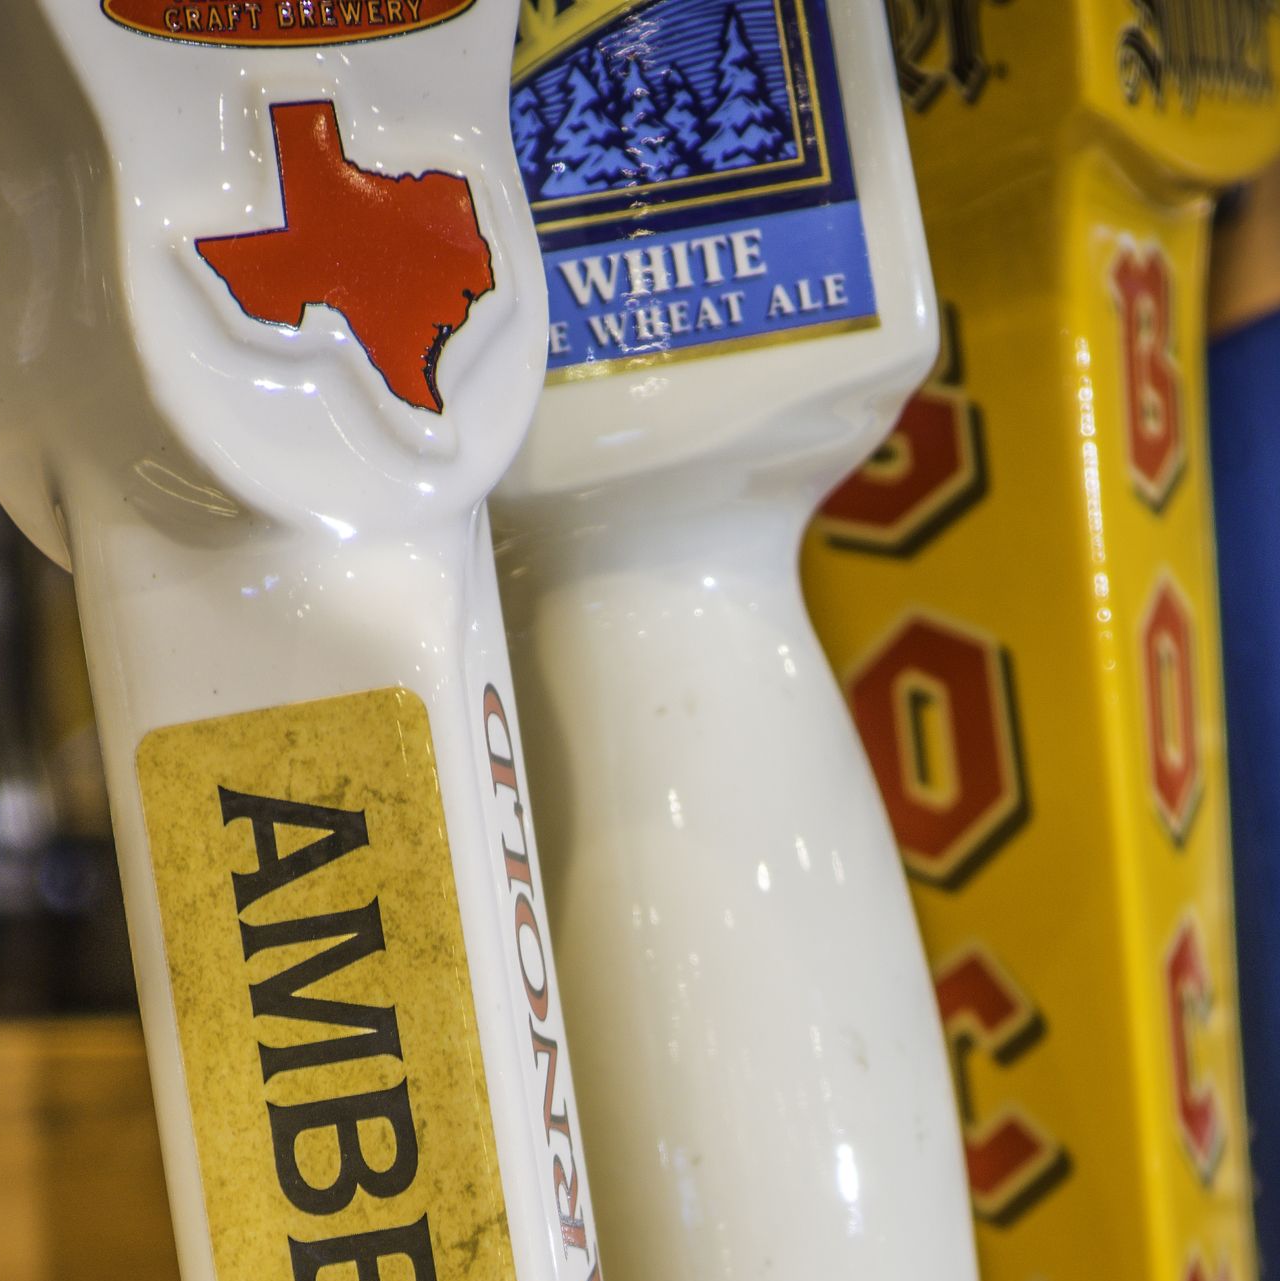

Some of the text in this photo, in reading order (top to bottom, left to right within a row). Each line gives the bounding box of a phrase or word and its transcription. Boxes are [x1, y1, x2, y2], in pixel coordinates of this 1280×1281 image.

[164, 0, 421, 32] CRAFT BREWERY
[559, 227, 767, 307] WHITE
[587, 290, 746, 348] WHEAT
[767, 273, 849, 318] ALE
